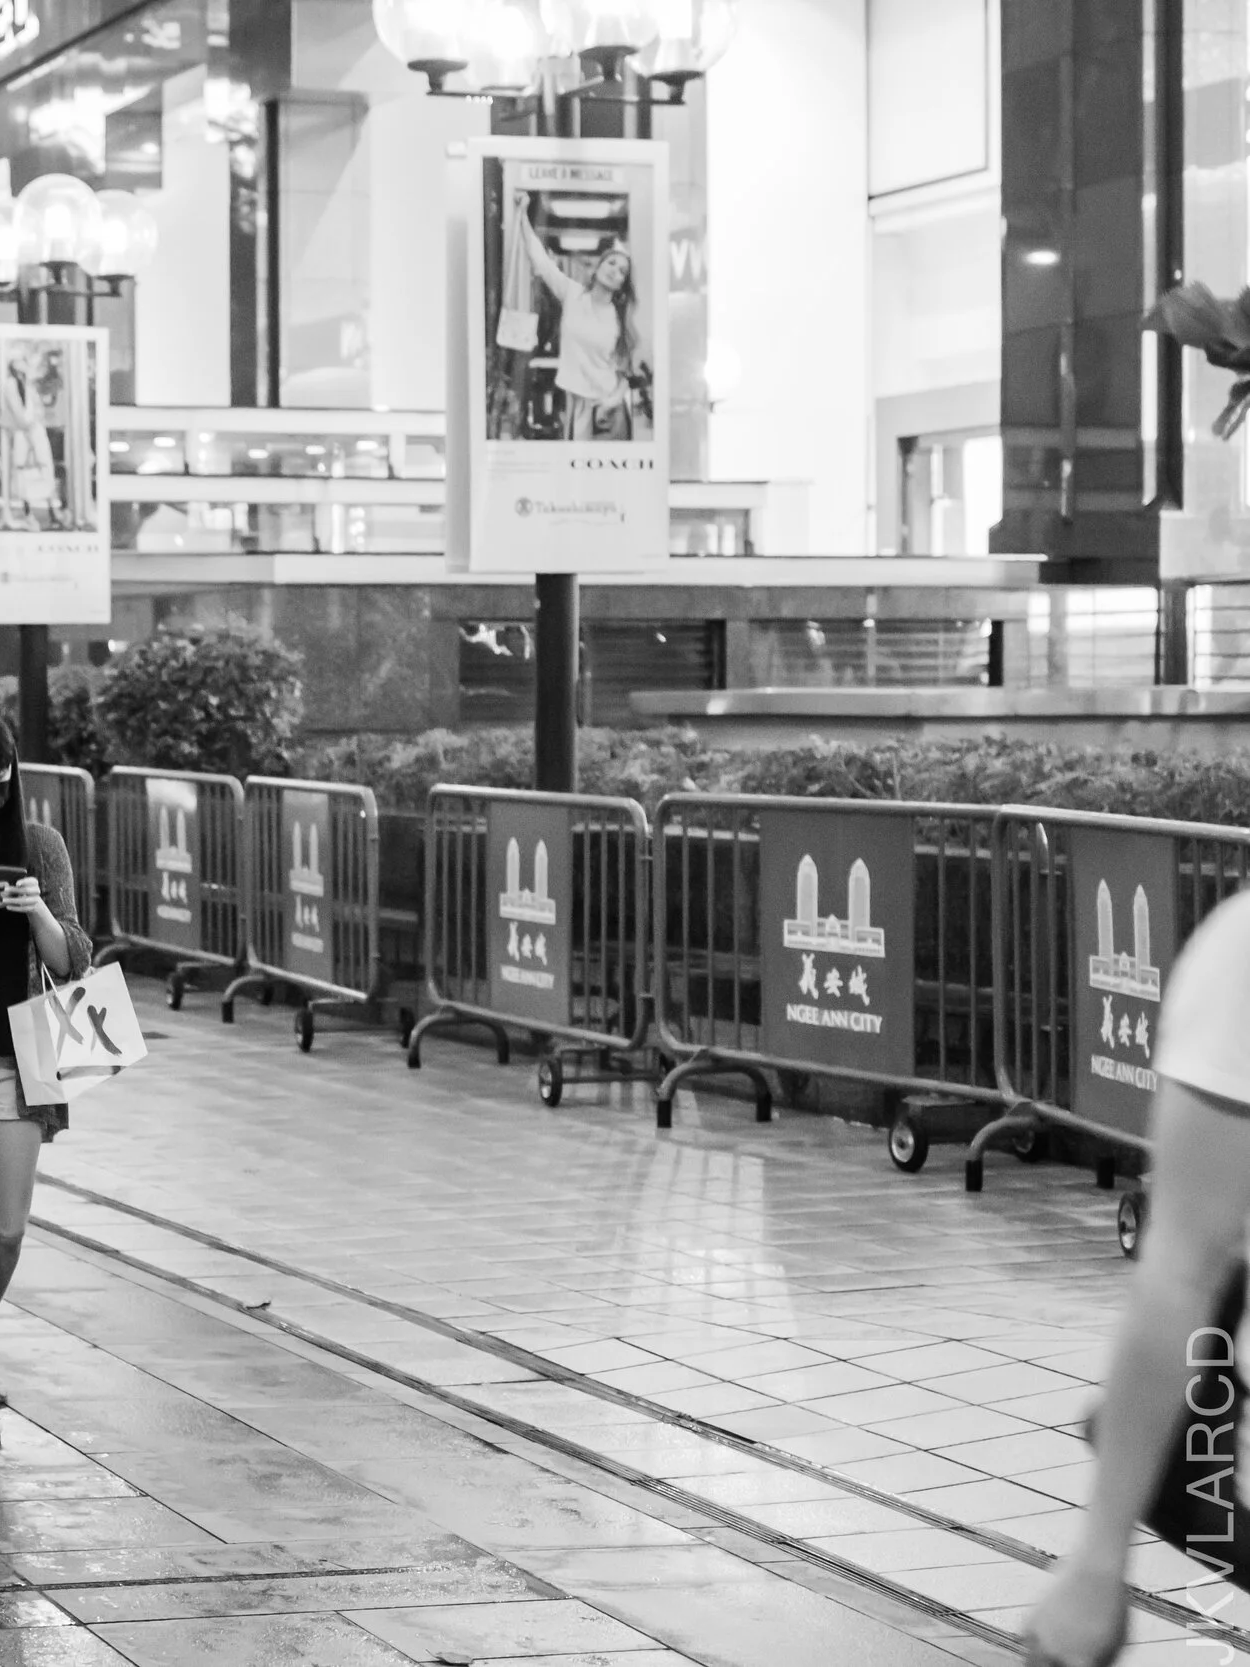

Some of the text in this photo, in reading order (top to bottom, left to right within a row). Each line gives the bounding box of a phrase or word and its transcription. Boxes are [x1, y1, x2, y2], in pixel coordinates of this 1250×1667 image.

[570, 458, 654, 470] COACH
[786, 1003, 883, 1034] NGEE ANN CITY
[1090, 1054, 1116, 1081] NGEE
